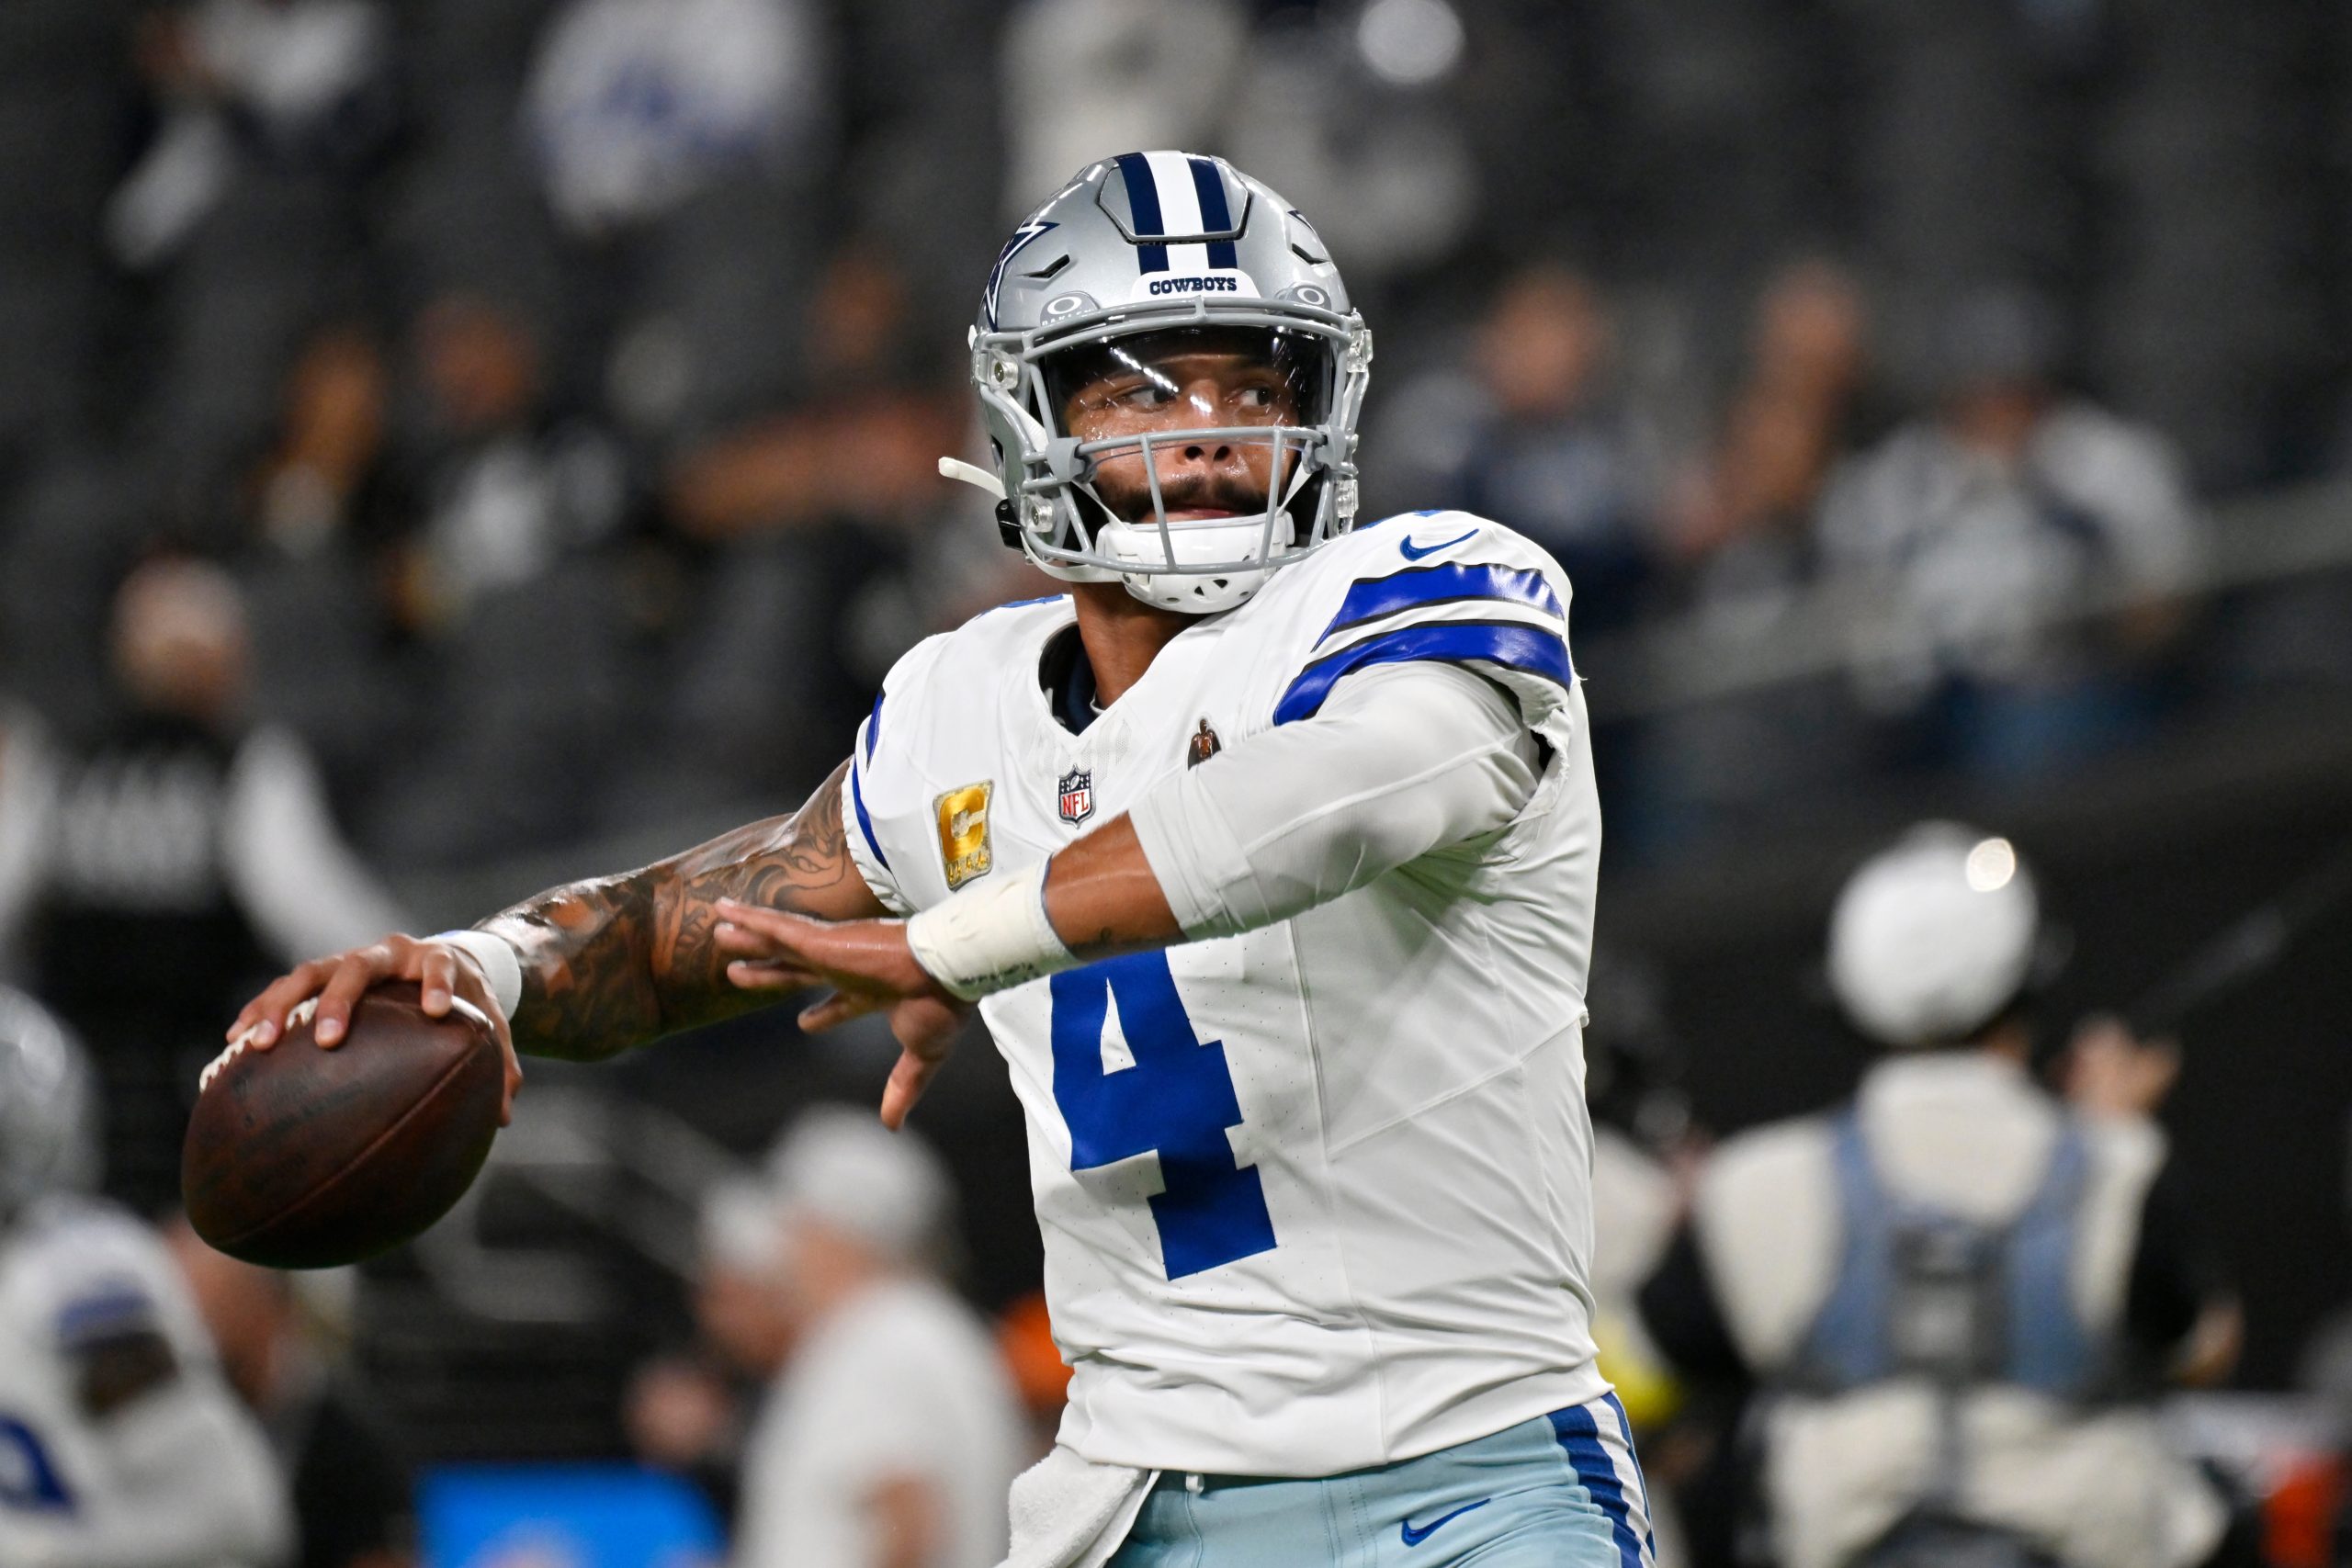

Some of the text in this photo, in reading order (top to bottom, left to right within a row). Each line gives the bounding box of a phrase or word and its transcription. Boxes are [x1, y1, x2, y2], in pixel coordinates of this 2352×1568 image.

[1149, 277, 1238, 295] COWBOYS
[939, 787, 985, 862] C
[1062, 792, 1089, 817] NFL
[1050, 948, 1278, 1280] 4
